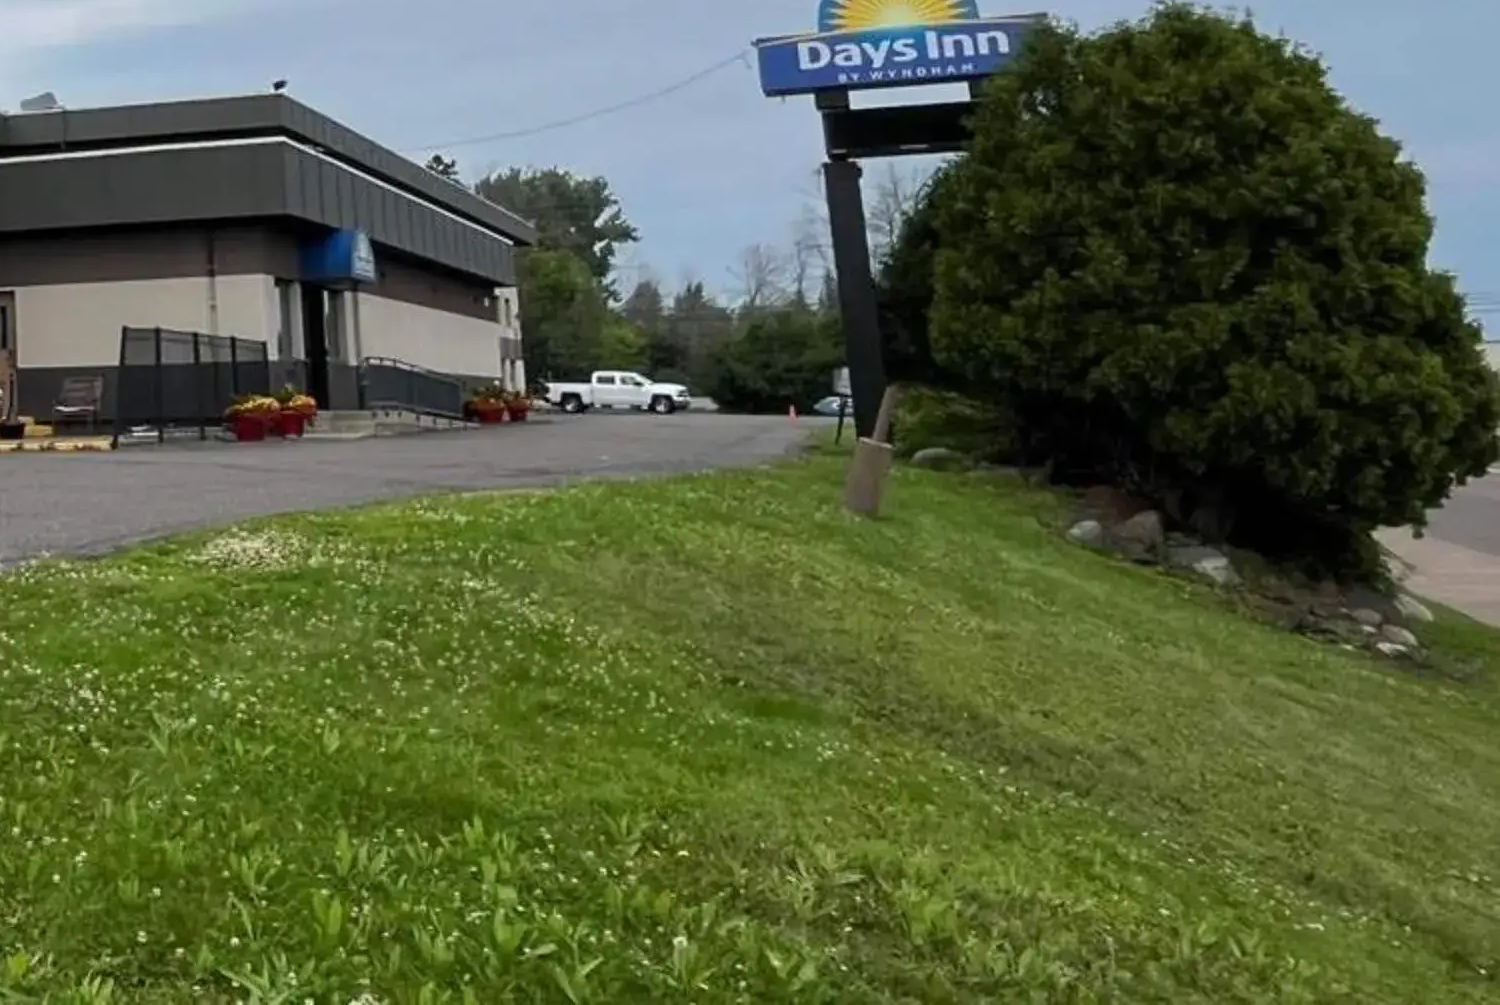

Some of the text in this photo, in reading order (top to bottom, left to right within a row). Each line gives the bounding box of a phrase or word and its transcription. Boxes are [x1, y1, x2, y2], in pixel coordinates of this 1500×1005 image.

[797, 29, 1010, 70] Days Inn
[837, 62, 974, 83] BY WYNDHAM
